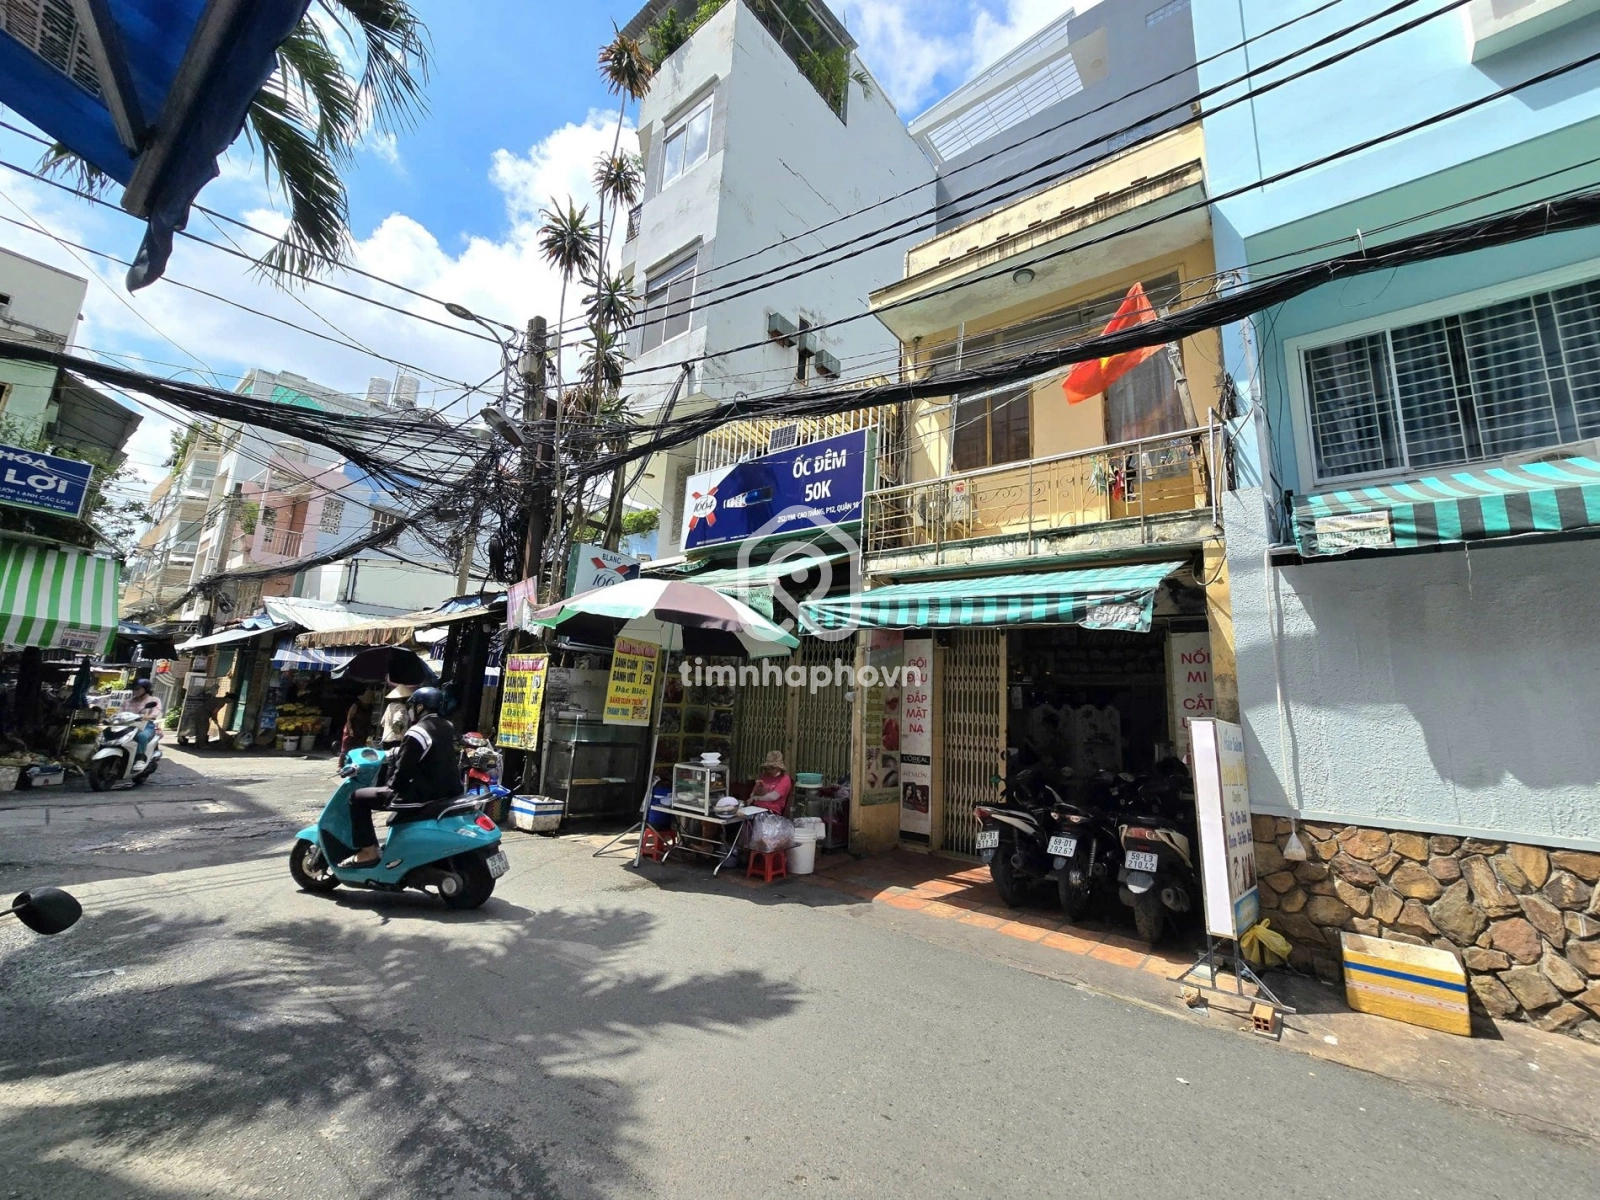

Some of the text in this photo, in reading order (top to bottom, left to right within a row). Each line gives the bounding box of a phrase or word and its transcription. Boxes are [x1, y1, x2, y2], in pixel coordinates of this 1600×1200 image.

[792, 448, 847, 478] ỐC ĐÊM
[4, 468, 69, 494] LỢI
[805, 479, 832, 502] 50K
[693, 499, 714, 512] 1664
[837, 502, 852, 513] QUẬN
[602, 553, 622, 564] BLANC
[592, 573, 622, 587] 166
[1181, 647, 1210, 664] NỐI
[642, 674, 652, 686] 25K
[1186, 671, 1207, 683] MI
[906, 690, 928, 704] ĐẮP
[1183, 693, 1214, 710] CẮT
[906, 706, 928, 720] MẶT
[909, 723, 924, 735] NẠ
[1053, 838, 1073, 848] 69-D1
[1048, 844, 1073, 855] 292.67
[1131, 852, 1154, 863] 59-L3
[1127, 859, 1155, 871] 210.42
